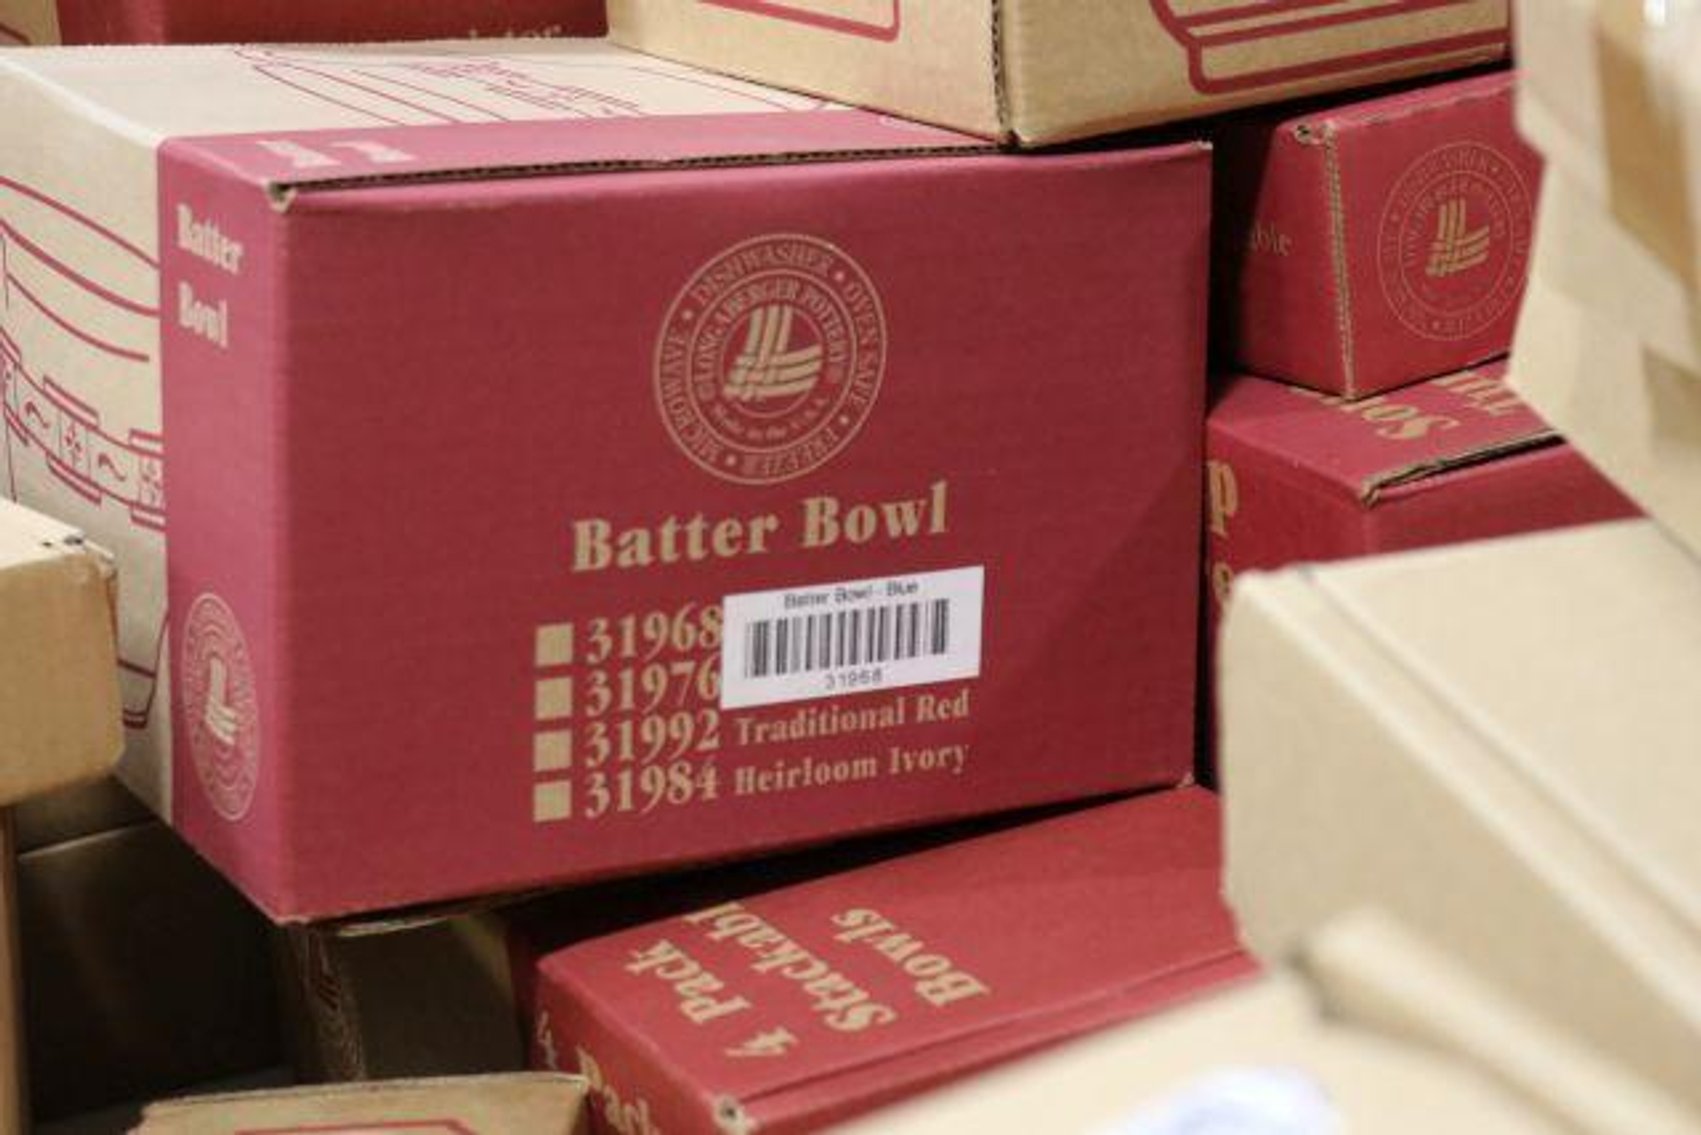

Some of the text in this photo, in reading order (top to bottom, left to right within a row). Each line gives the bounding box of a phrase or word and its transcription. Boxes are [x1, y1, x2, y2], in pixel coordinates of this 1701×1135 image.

[177, 203, 243, 275] Batter
[690, 243, 834, 305] DISHWASHER
[179, 280, 227, 348] Bowl
[661, 326, 726, 463] MICROWAVE
[572, 480, 948, 572] Batter Bowl
[835, 585, 873, 603] Bowl
[887, 581, 919, 597] Blue
[586, 602, 722, 664] 31968
[585, 653, 720, 717] 31976
[585, 688, 969, 768] 31992 Traditional Red
[585, 744, 969, 820] 31984 Heirloom Ivory
[626, 939, 751, 1024] Pack
[831, 908, 992, 1008] Bowls
